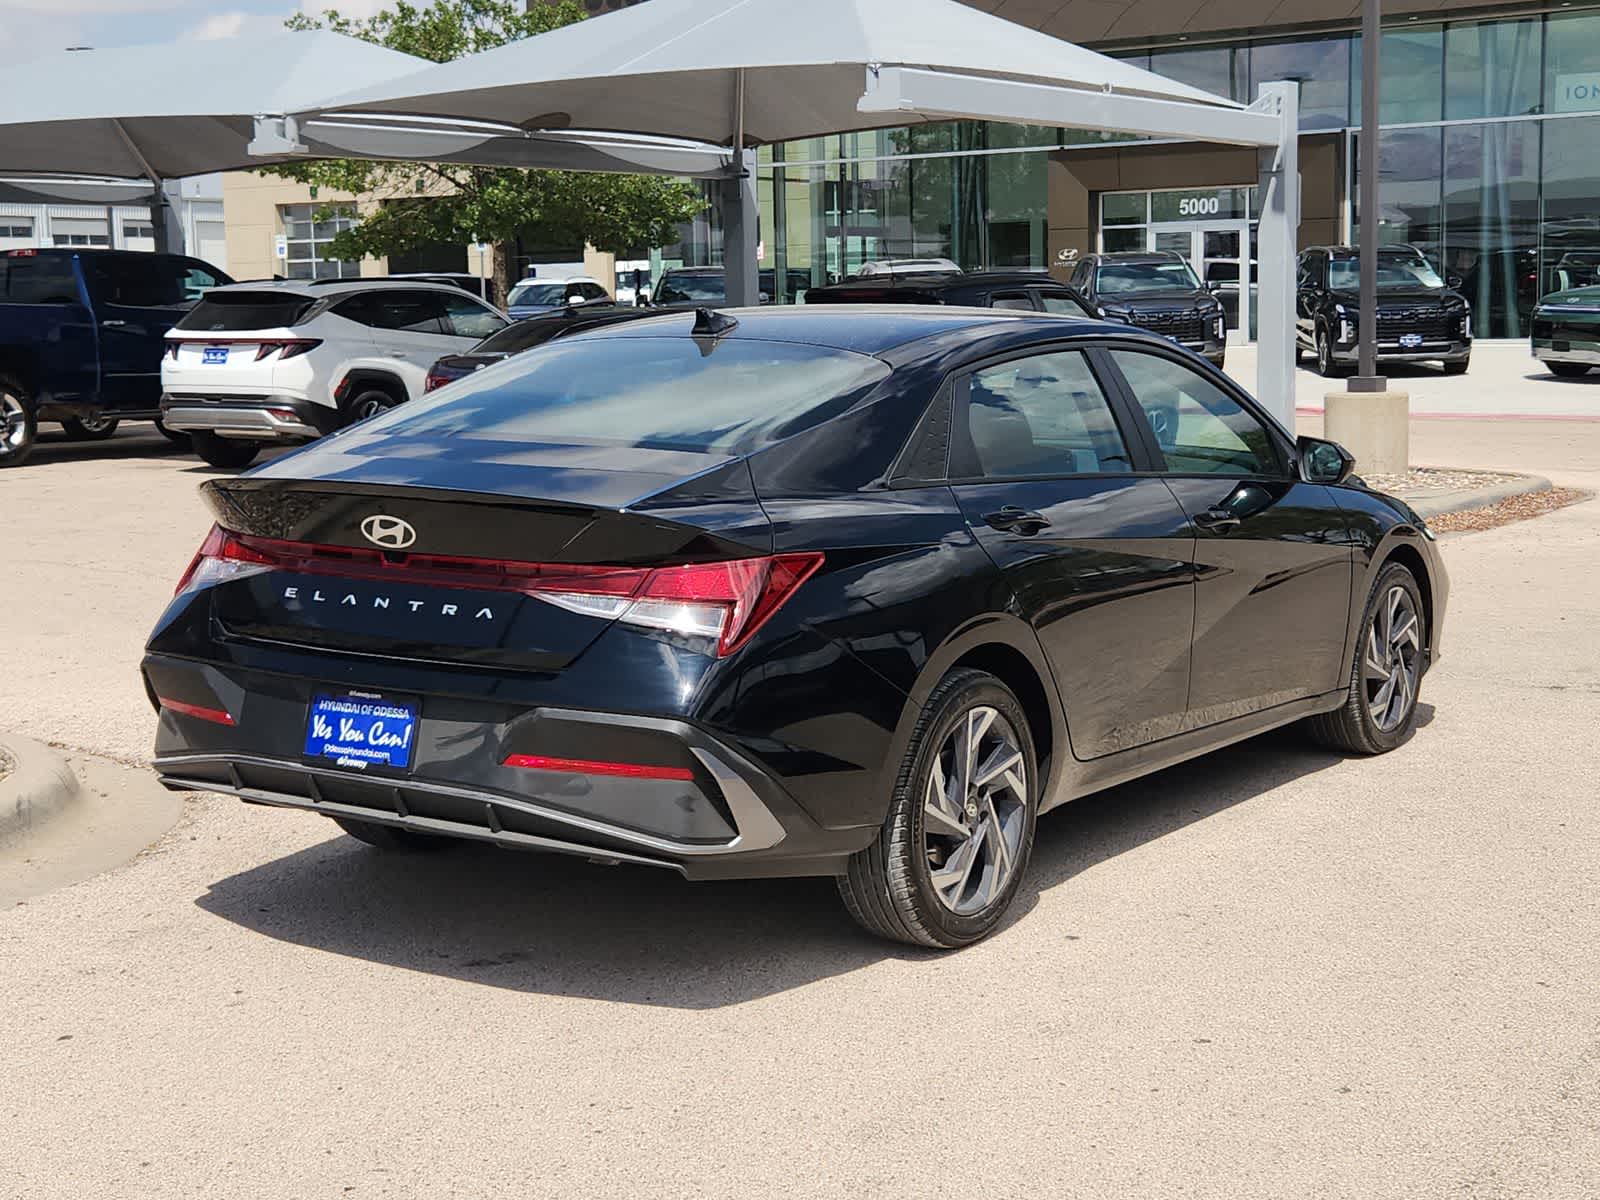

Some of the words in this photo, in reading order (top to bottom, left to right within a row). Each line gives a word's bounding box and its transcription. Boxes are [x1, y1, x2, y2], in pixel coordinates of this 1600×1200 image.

[1179, 197, 1218, 215] 5000
[284, 587, 493, 619] ELANTRA
[319, 700, 360, 714] HYUNDAI
[361, 704, 374, 715] OF
[373, 706, 410, 719] ODESSA
[312, 714, 333, 739] Yes
[338, 718, 365, 742] You
[368, 721, 412, 749] Can!
